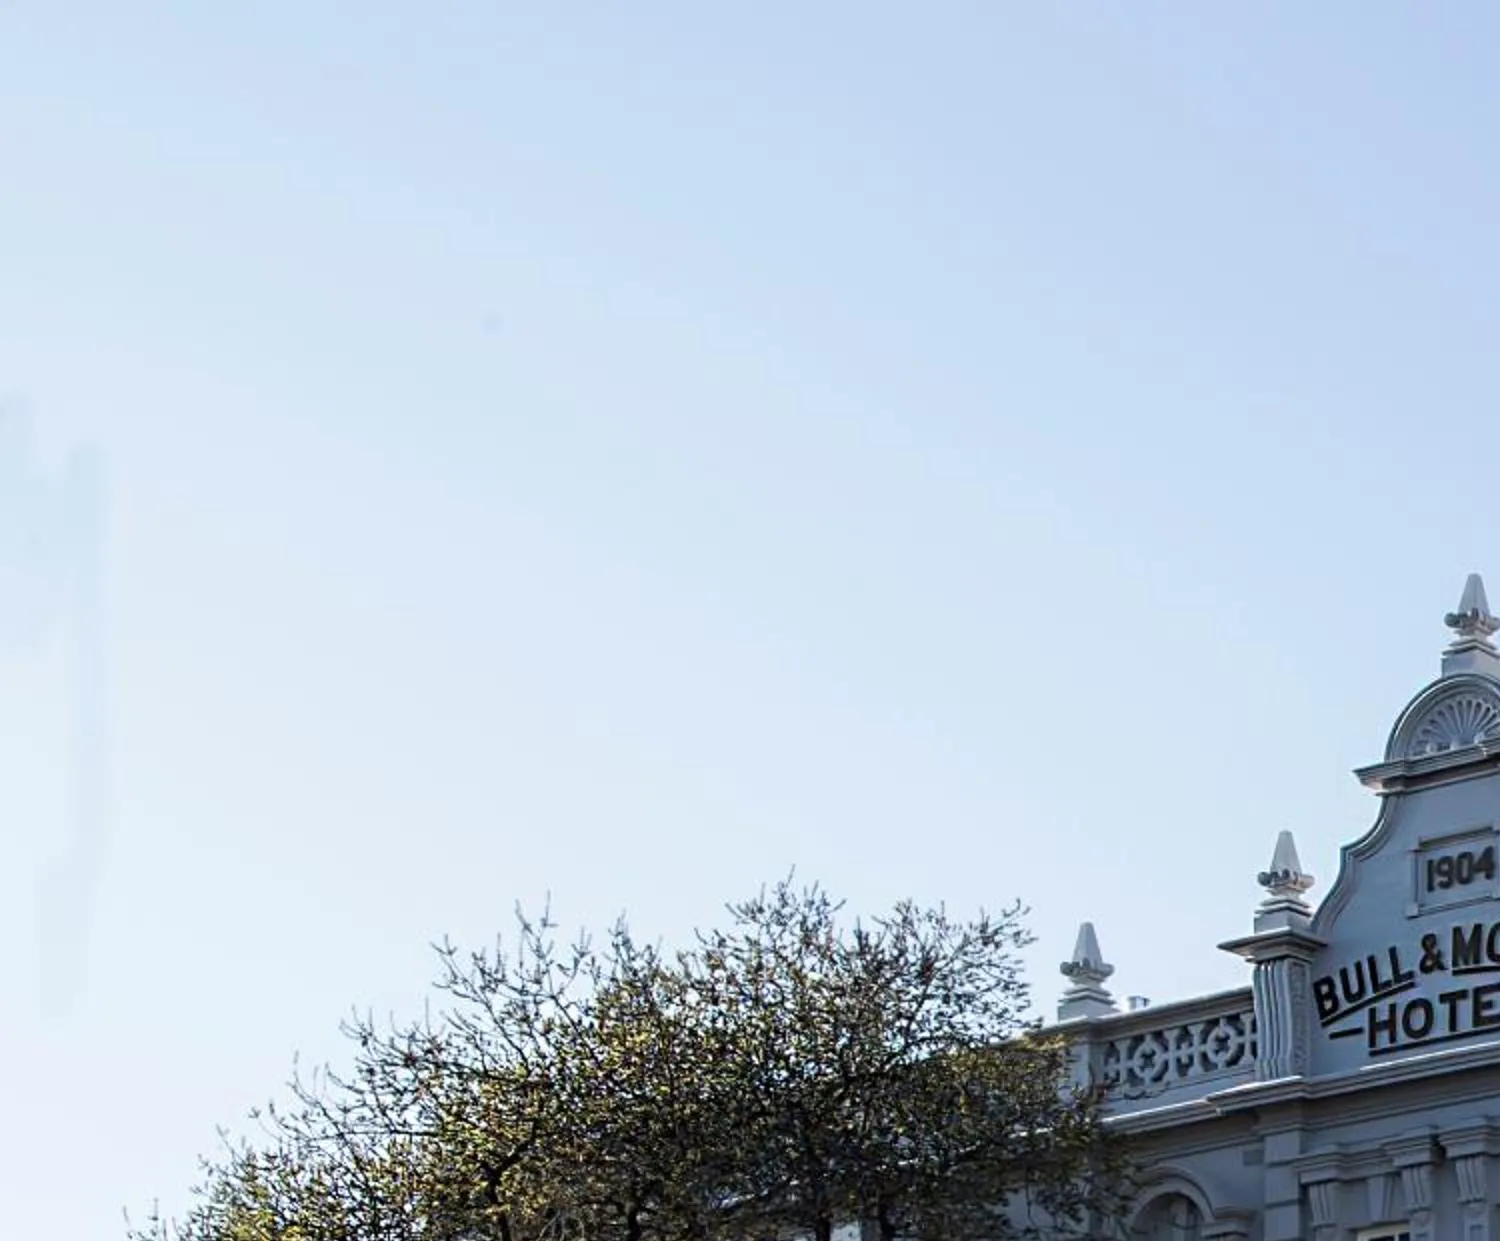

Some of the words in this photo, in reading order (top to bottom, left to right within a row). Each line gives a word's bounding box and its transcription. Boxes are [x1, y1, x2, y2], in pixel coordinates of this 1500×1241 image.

[1426, 846, 1496, 892] 1904
[1313, 946, 1416, 1020] BULL
[1419, 933, 1448, 974] &
